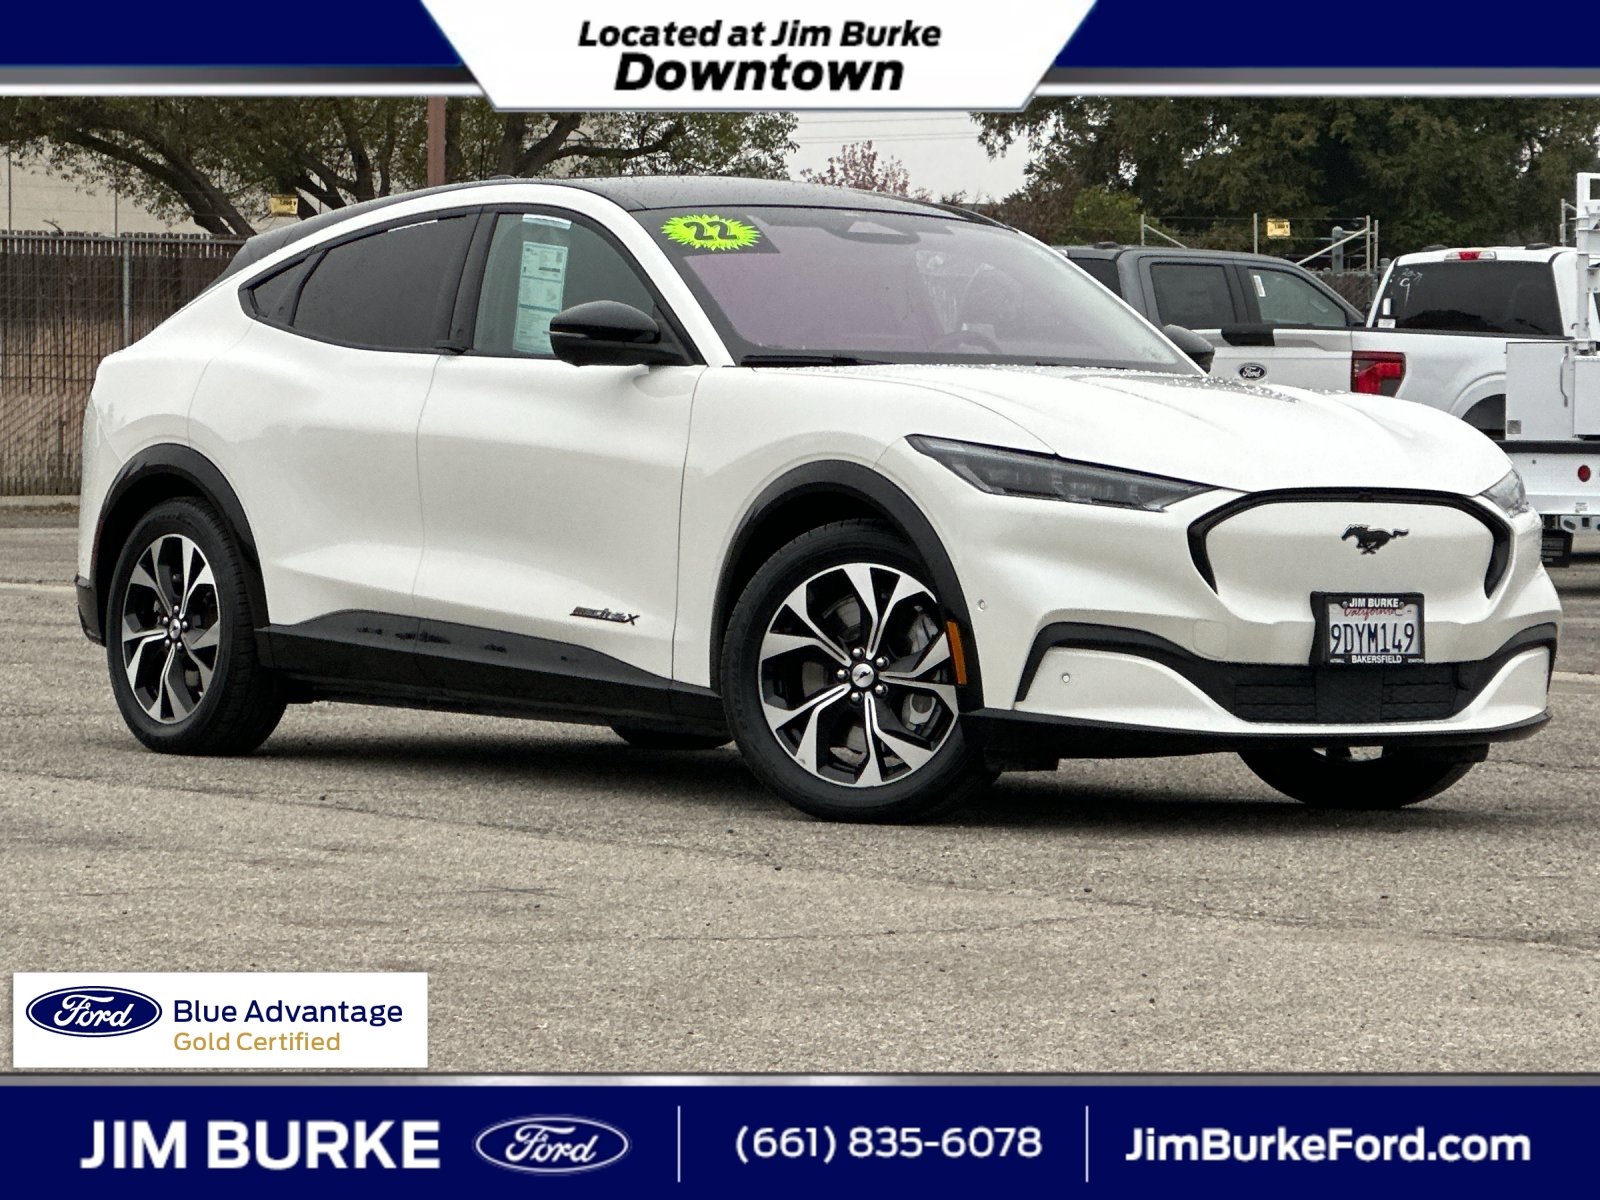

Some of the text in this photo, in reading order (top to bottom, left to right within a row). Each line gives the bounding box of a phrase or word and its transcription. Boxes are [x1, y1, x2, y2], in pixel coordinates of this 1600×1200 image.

[683, 220, 738, 241] 22
[1242, 366, 1262, 378] Ford
[1349, 598, 1399, 608] JIM BURKE
[1330, 622, 1415, 654] 9DYM149
[1351, 655, 1402, 664] BAKERSFIELD
